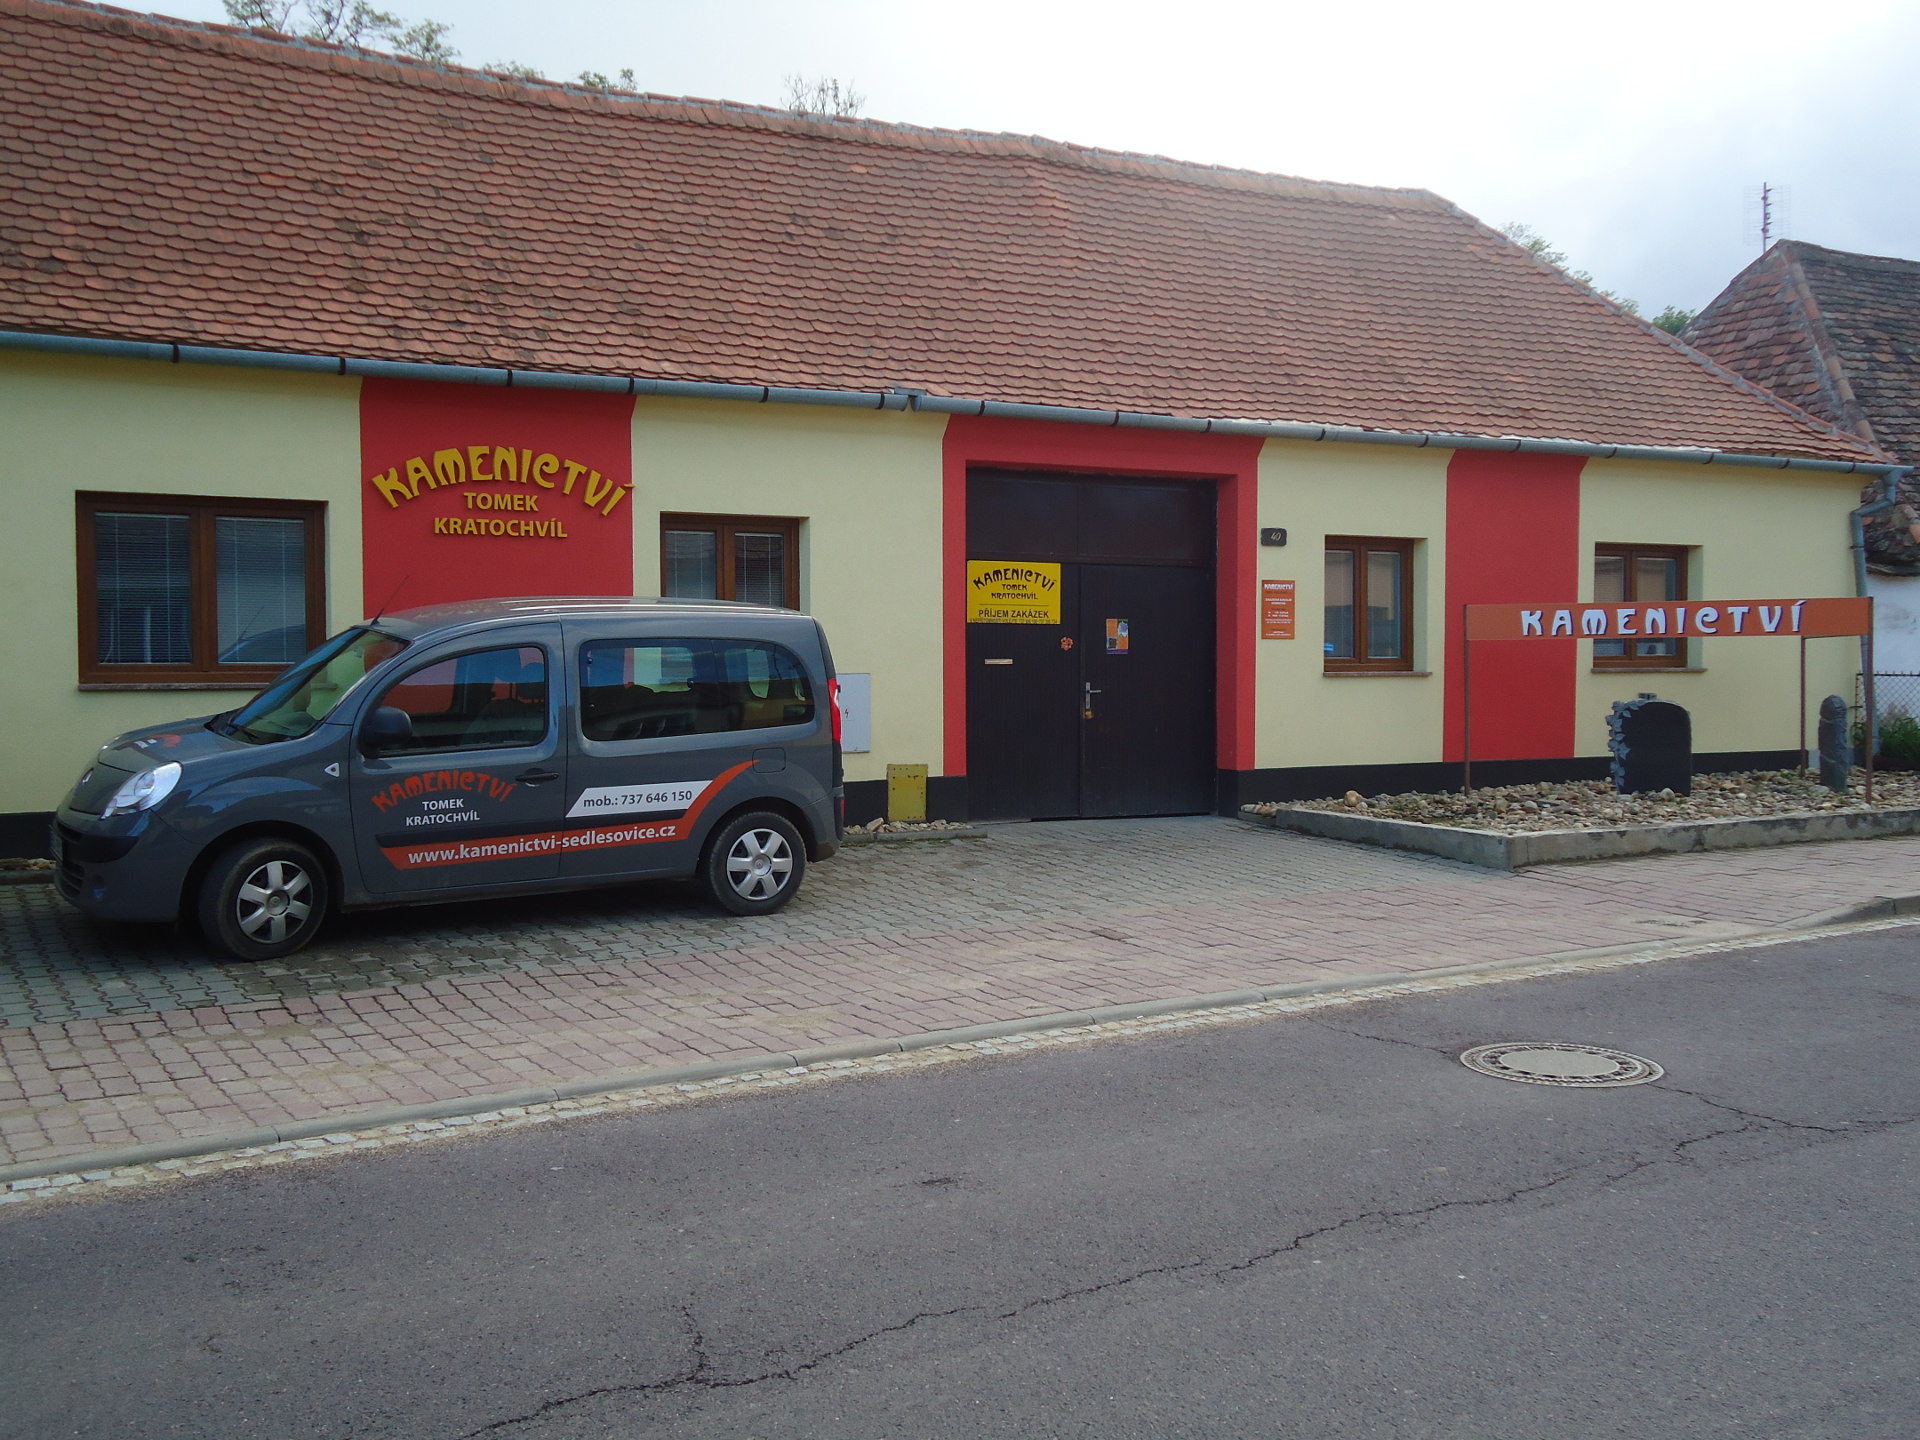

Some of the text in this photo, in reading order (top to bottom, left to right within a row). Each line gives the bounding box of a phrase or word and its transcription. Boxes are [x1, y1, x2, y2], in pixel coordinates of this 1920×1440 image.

[372, 446, 636, 516] KAMENICTVÍ
[463, 492, 539, 512] TOMEK
[434, 517, 568, 538] KRATOCHVÍL
[1270, 532, 1282, 541] 40
[973, 568, 1057, 591] KAMENICTVÍ
[991, 592, 1038, 600] KRATOCHVÍL
[978, 608, 1048, 618] PŘÍJEM ZAKÁZEK
[1520, 600, 1806, 636] KAMENICTVÍ
[371, 770, 516, 812] KAMENICTVÍ
[583, 790, 693, 808] mob.: 737 646 150
[422, 798, 465, 811] TOMEK
[405, 810, 480, 827] KRATOCHVÍL
[408, 825, 676, 863] www.kamenictvi-sedlesovice.cz
